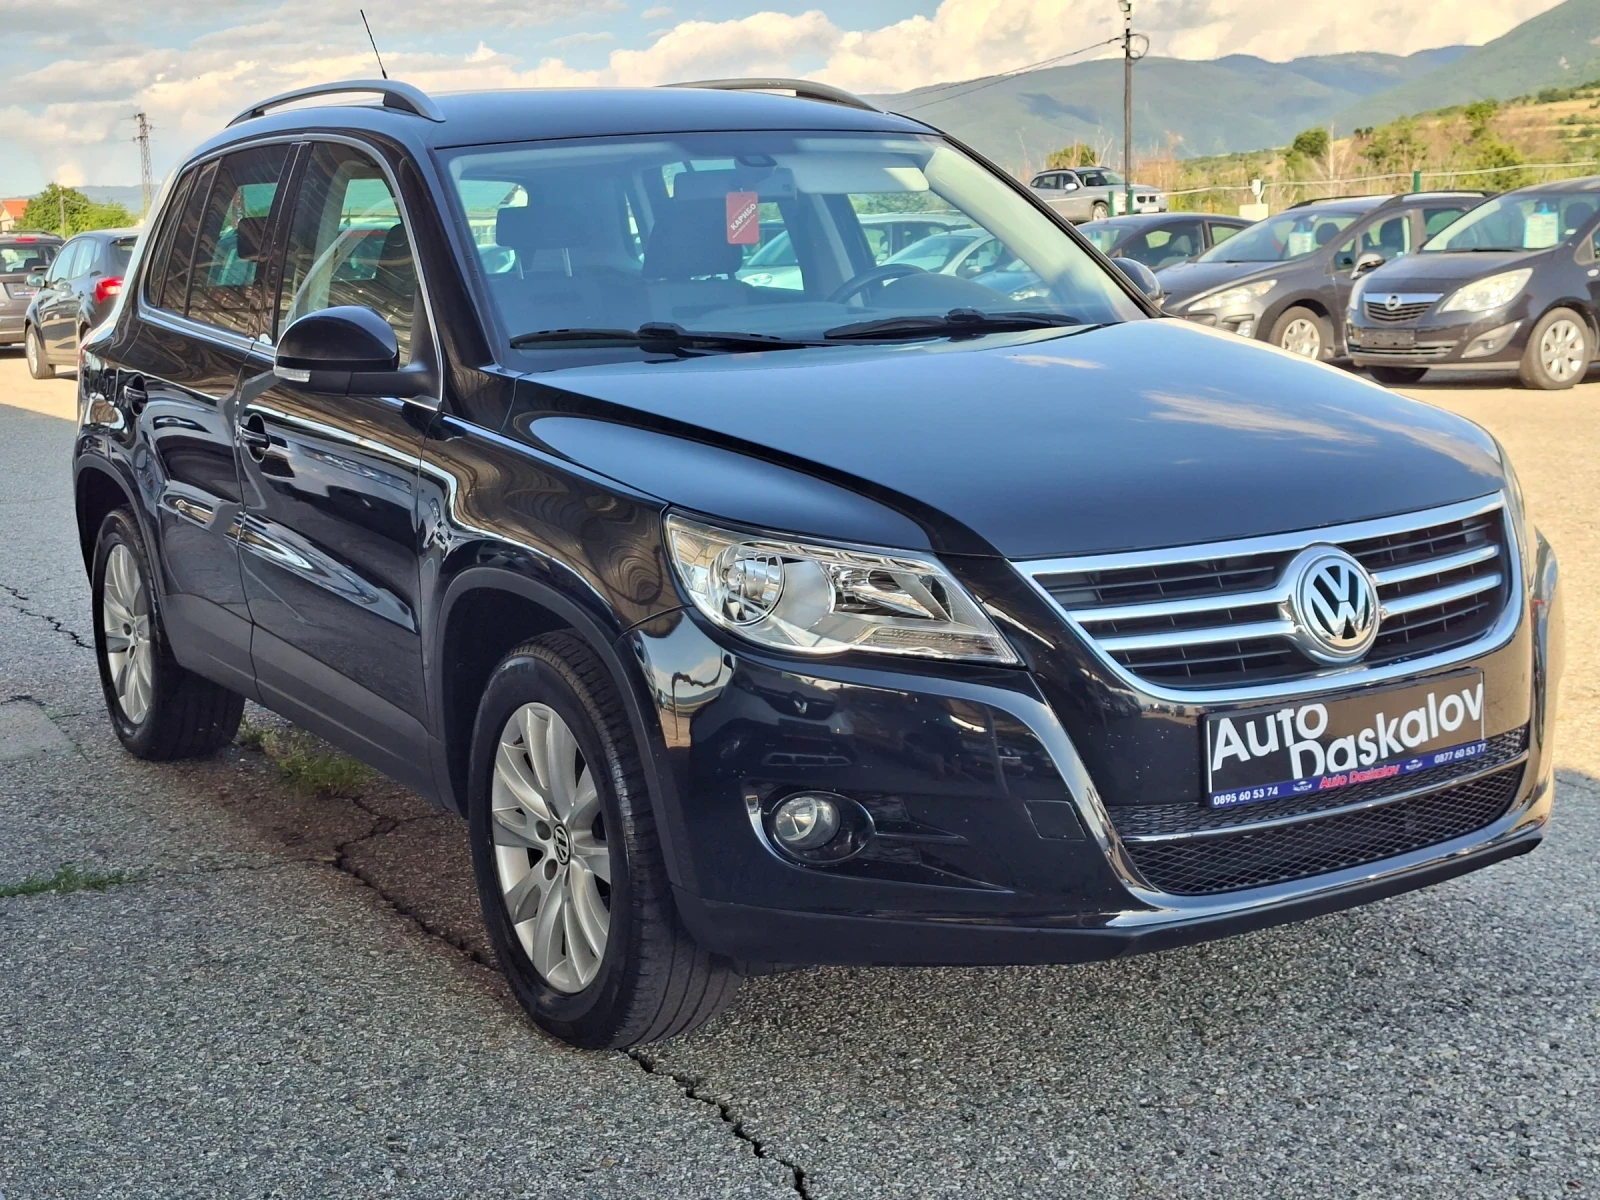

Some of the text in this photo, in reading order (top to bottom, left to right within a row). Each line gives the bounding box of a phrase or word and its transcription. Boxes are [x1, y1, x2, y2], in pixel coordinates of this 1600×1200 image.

[730, 203, 757, 231] КАРИБО
[1212, 703, 1329, 771] Auto
[1289, 683, 1484, 780] Daskalov
[1434, 743, 1487, 764] 0877 60 53 77
[1319, 764, 1401, 789] Auto Daskalov
[1213, 786, 1279, 806] 0895 60 53 74
